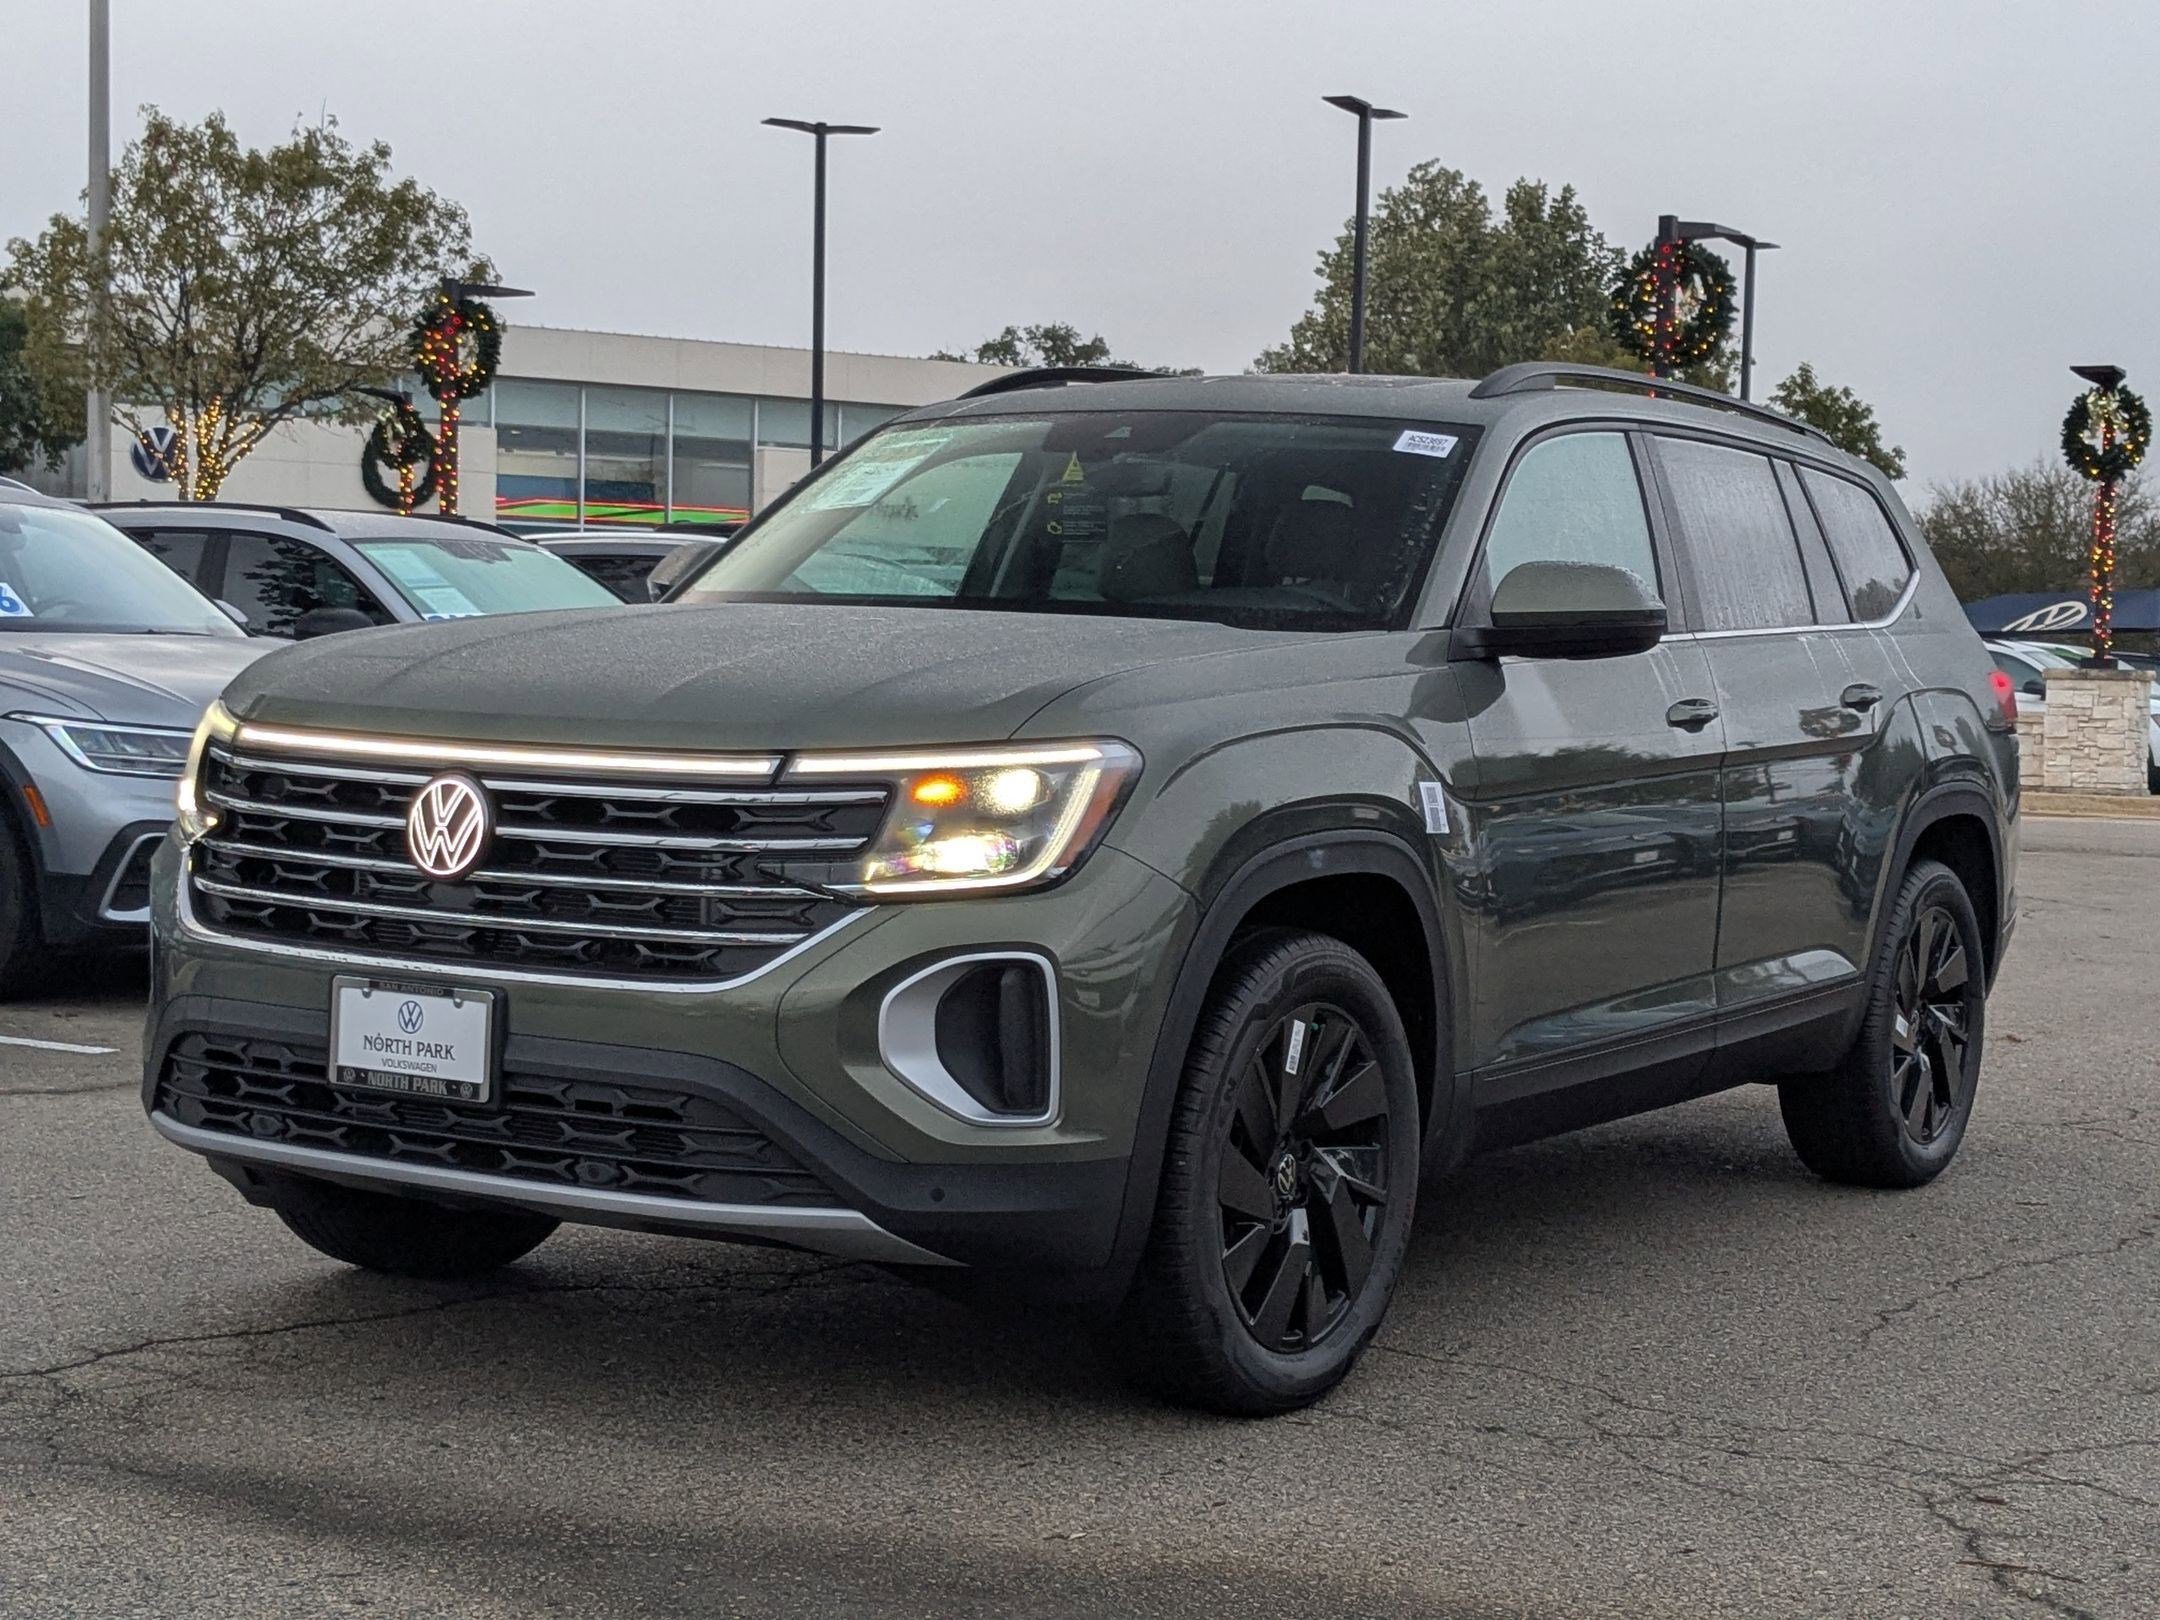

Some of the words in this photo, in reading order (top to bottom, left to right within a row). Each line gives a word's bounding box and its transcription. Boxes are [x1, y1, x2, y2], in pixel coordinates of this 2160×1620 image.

[379, 981, 399, 992] SAN
[401, 983, 444, 996] ANTONIO
[363, 1034, 412, 1056] NORTH
[416, 1041, 456, 1061] PARK
[381, 1058, 439, 1073] VOLKSWAGEN
[367, 1071, 409, 1090] NORTH
[412, 1077, 448, 1095] PARK
